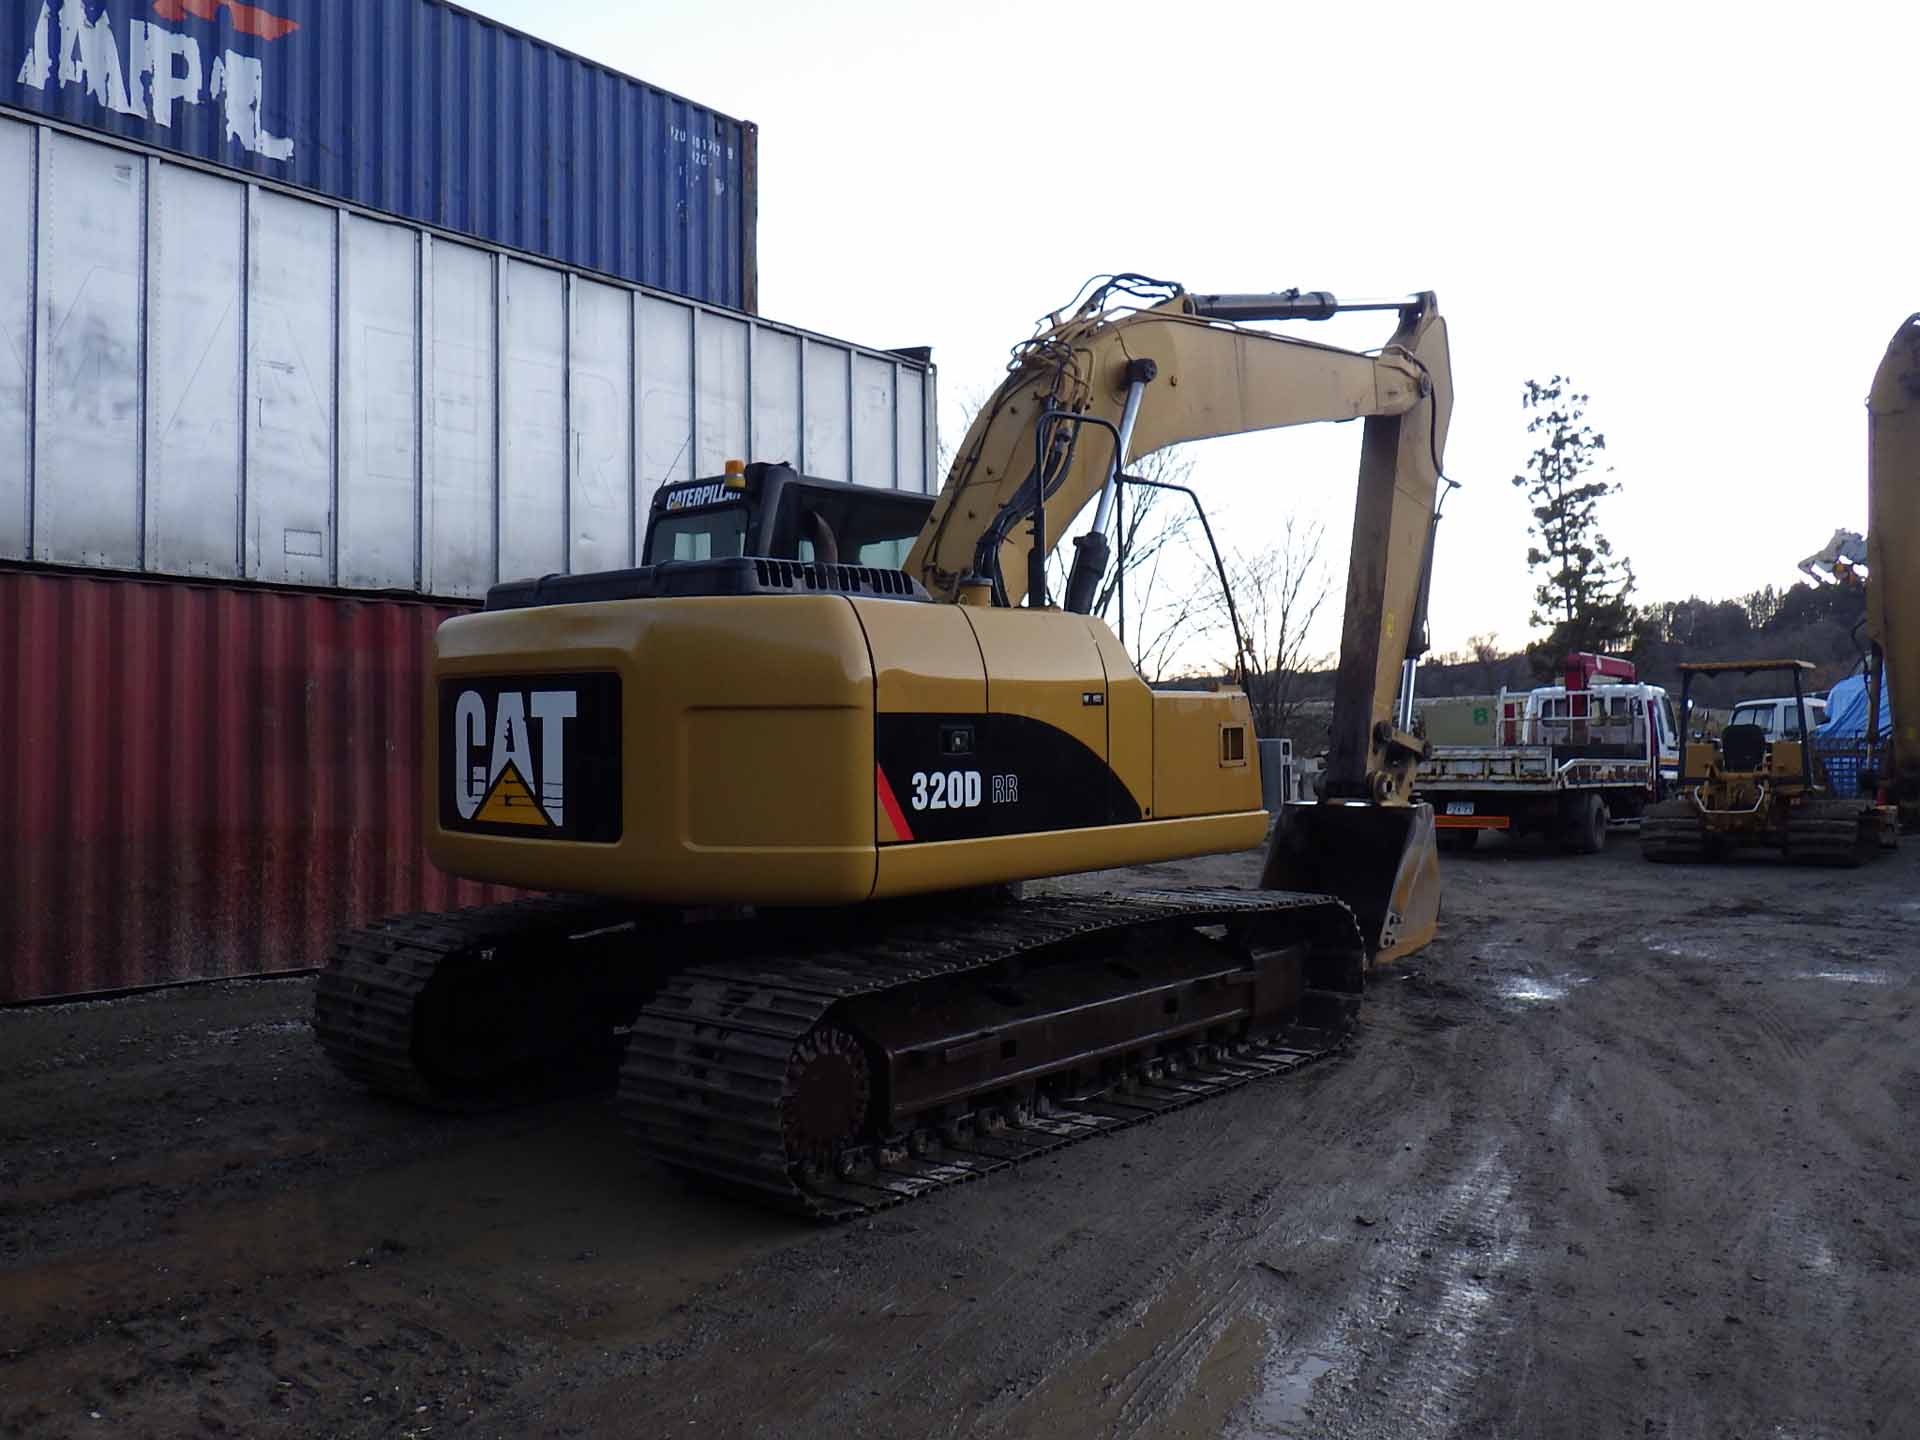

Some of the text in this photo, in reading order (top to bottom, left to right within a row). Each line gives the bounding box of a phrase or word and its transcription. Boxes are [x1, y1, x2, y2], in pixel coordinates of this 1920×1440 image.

[456, 690, 577, 827] CAT
[912, 771, 1018, 810] 320D RR
